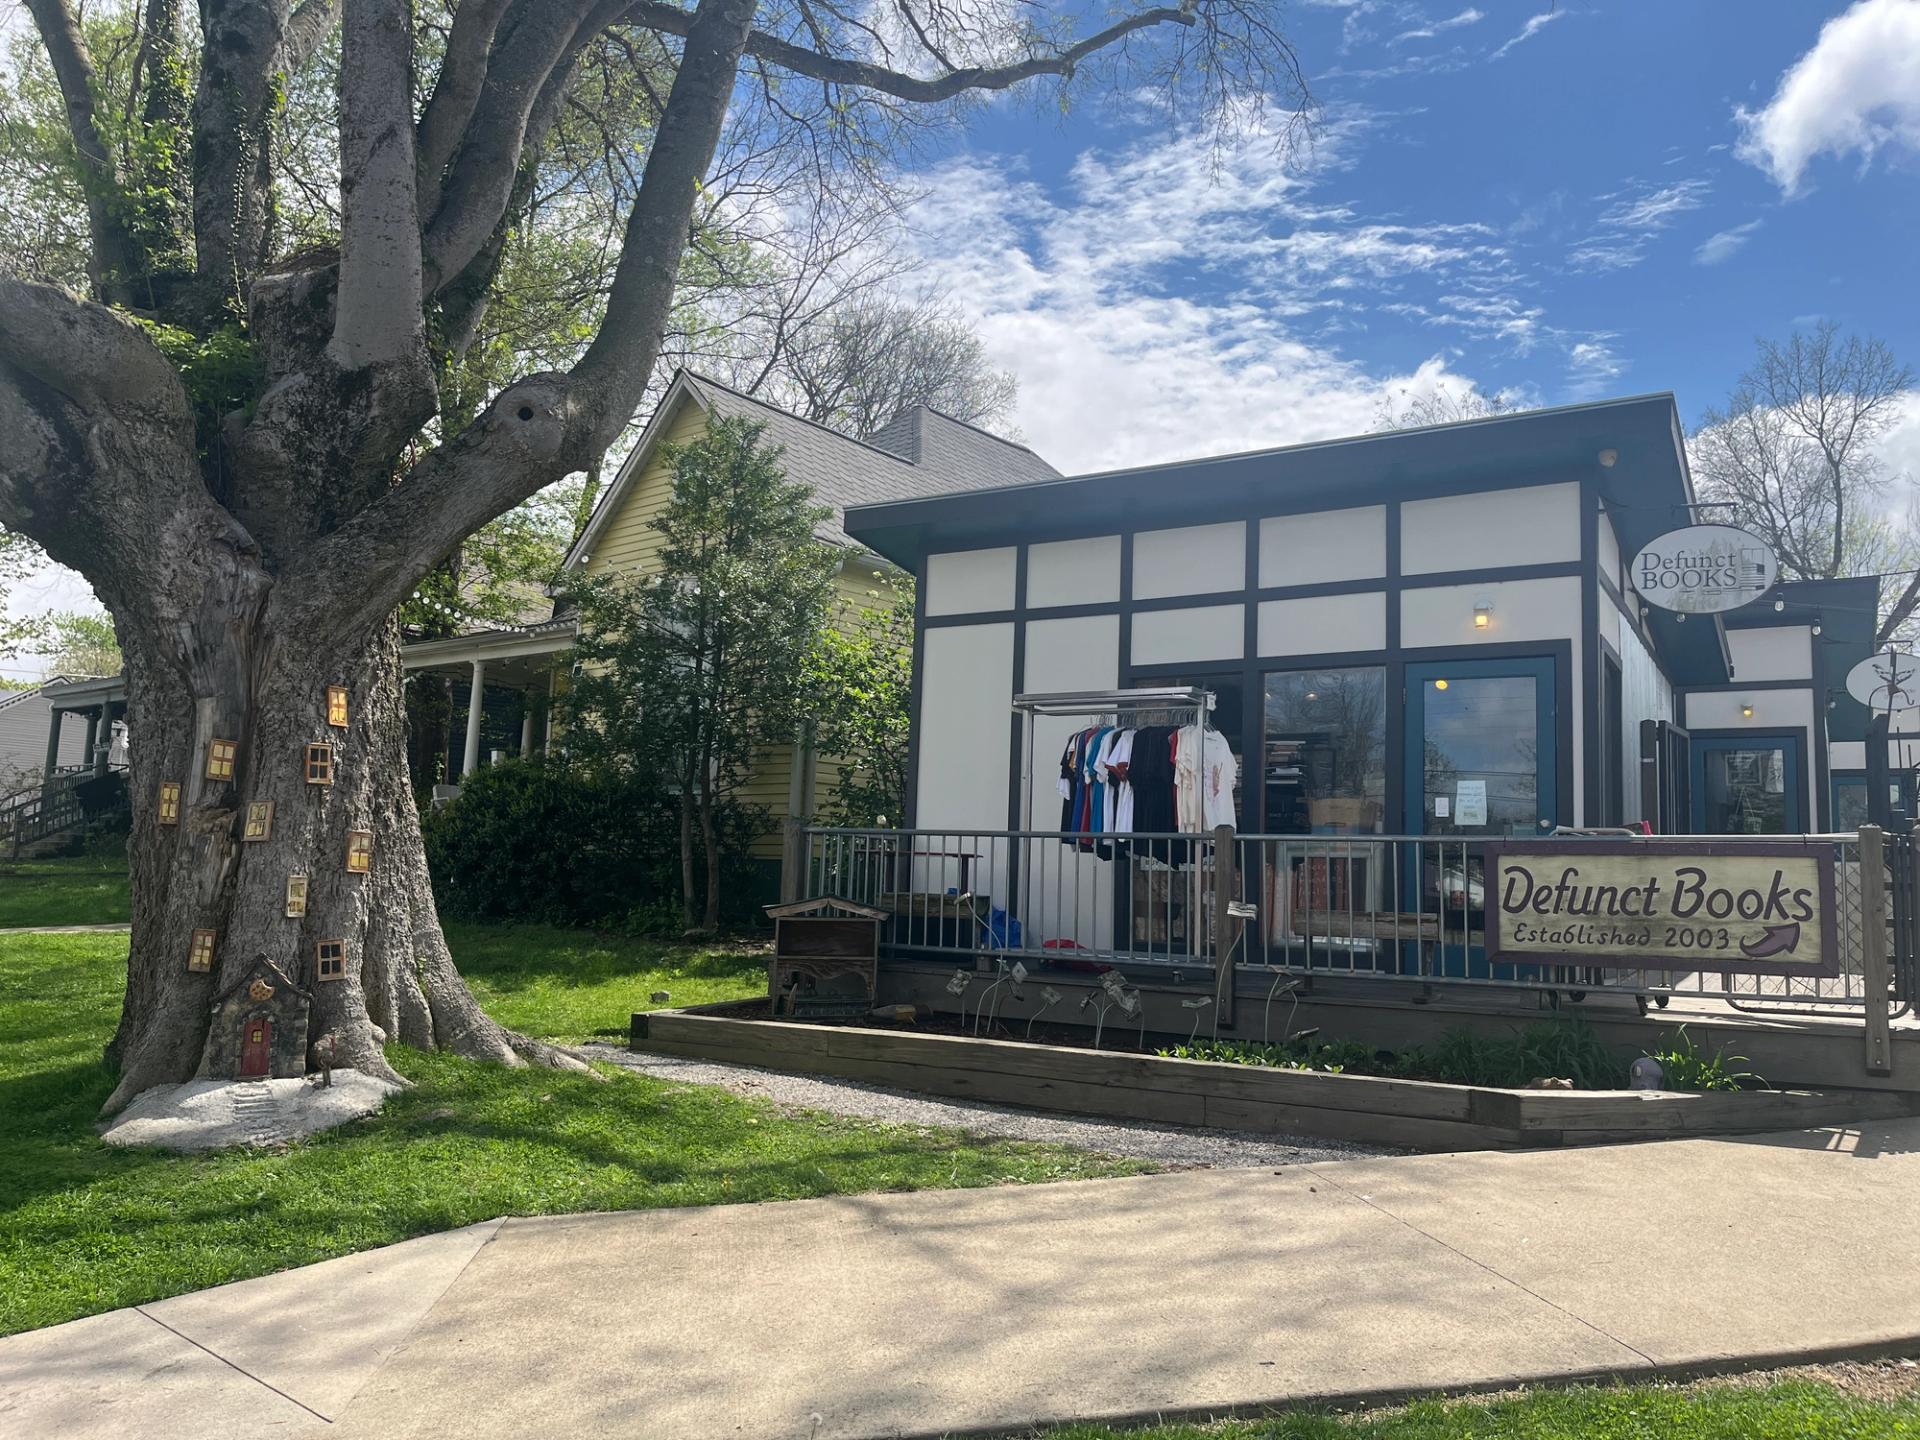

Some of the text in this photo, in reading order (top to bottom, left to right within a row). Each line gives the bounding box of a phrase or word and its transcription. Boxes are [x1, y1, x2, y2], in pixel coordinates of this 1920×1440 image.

[1641, 550, 1737, 571] Defunct
[1641, 568, 1737, 590] BOOKS
[1502, 865, 1814, 922] Defunct Books
[1513, 922, 1730, 949] Established 2003
